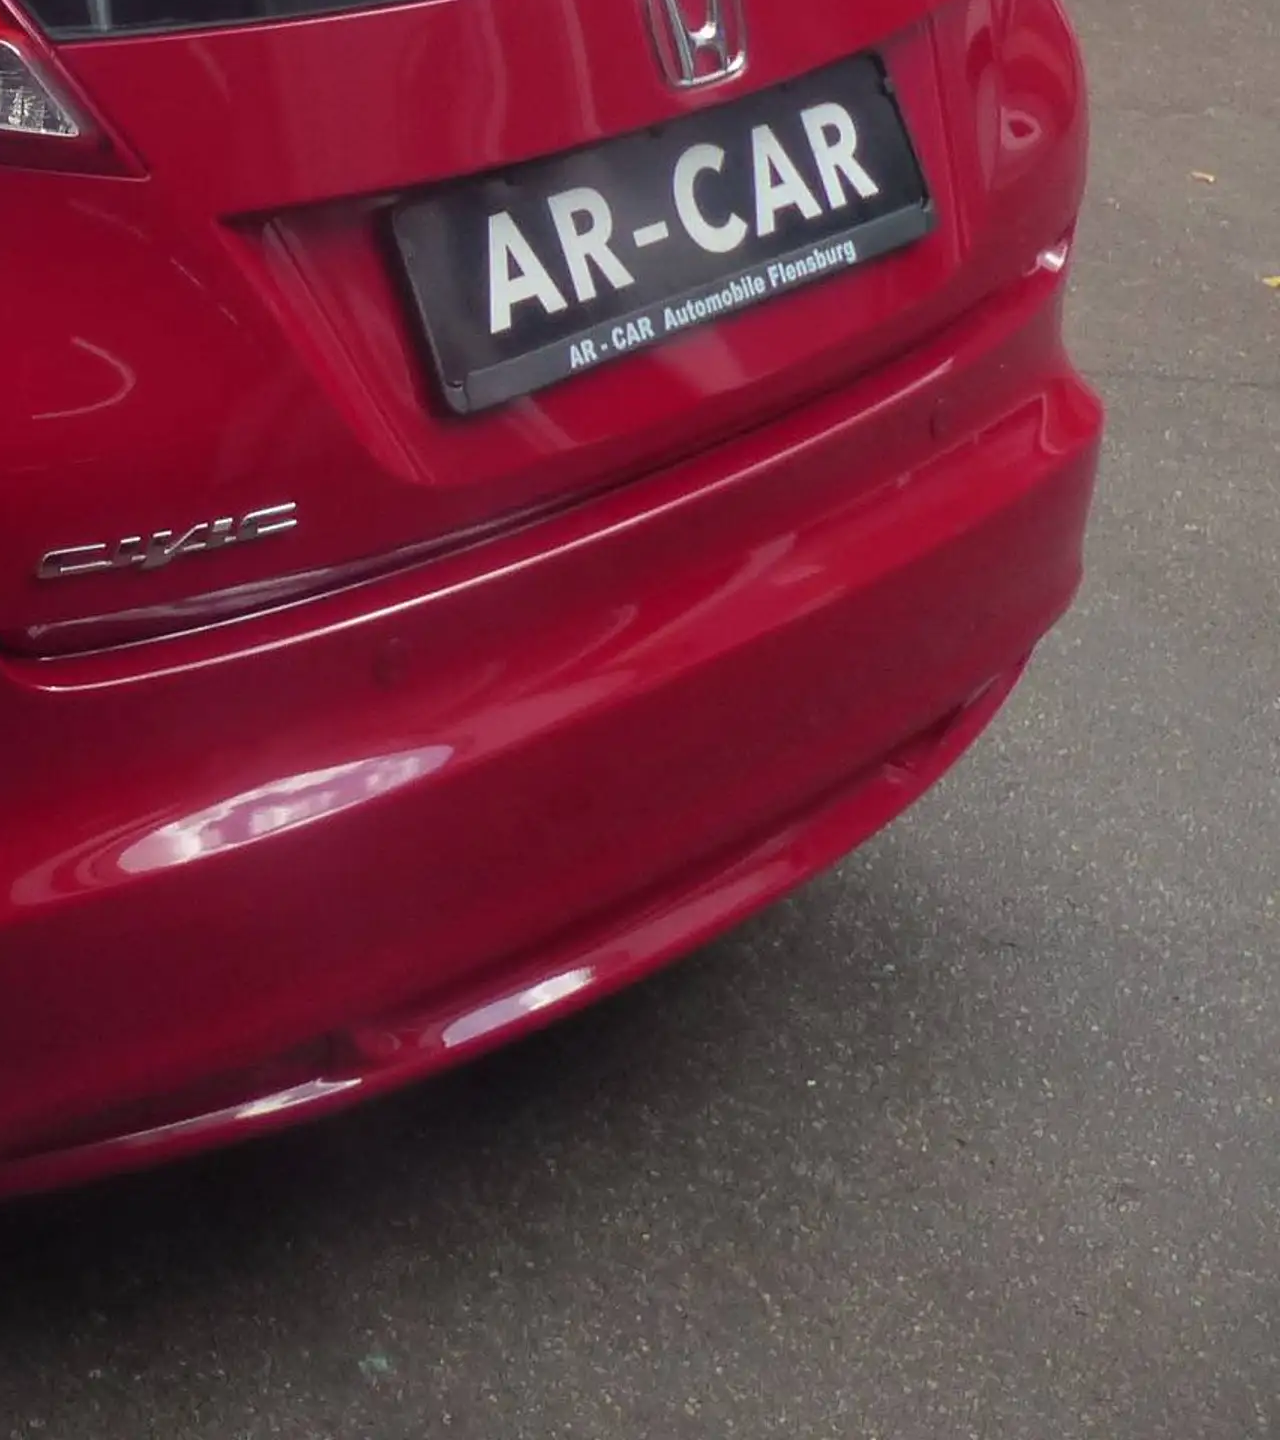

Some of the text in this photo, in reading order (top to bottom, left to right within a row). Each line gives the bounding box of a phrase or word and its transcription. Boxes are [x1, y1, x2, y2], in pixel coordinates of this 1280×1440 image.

[488, 102, 878, 333] AR-CAR
[569, 340, 598, 368] AR
[611, 317, 654, 350] CAR
[663, 275, 766, 331] Automobile
[767, 239, 856, 288] Flensburg
[37, 501, 298, 580] CIVIC
